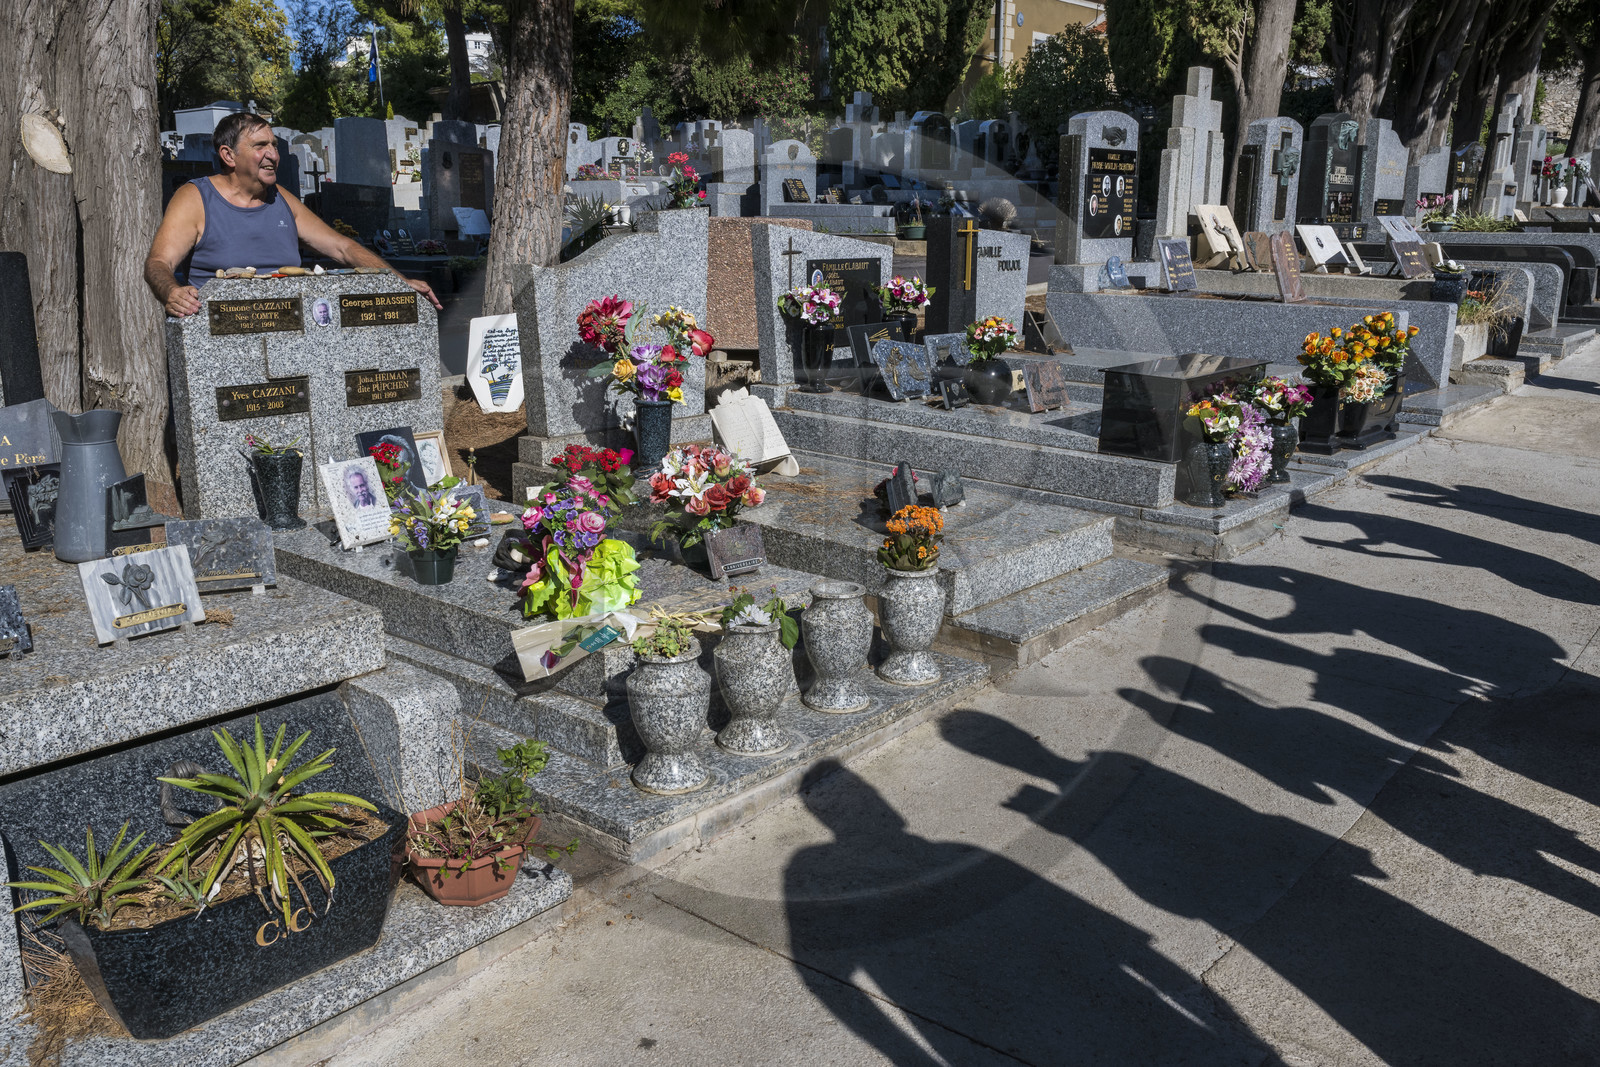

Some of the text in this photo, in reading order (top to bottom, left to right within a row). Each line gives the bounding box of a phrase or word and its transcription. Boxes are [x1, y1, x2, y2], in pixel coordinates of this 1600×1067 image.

[220, 301, 292, 313] Simone CAZZANI
[341, 295, 415, 308] Georges BRASSENS
[251, 312, 280, 320] COMTE
[360, 312, 376, 321] 1921
[384, 311, 399, 320] 1981
[375, 370, 408, 382] HEIMAN
[231, 385, 296, 401] Yves CAZZANI
[357, 385, 370, 394] dite
[246, 403, 260, 412] 1915
[267, 401, 284, 410] 2003
[727, 559, 758, 571] ANNIVERSAIRE
